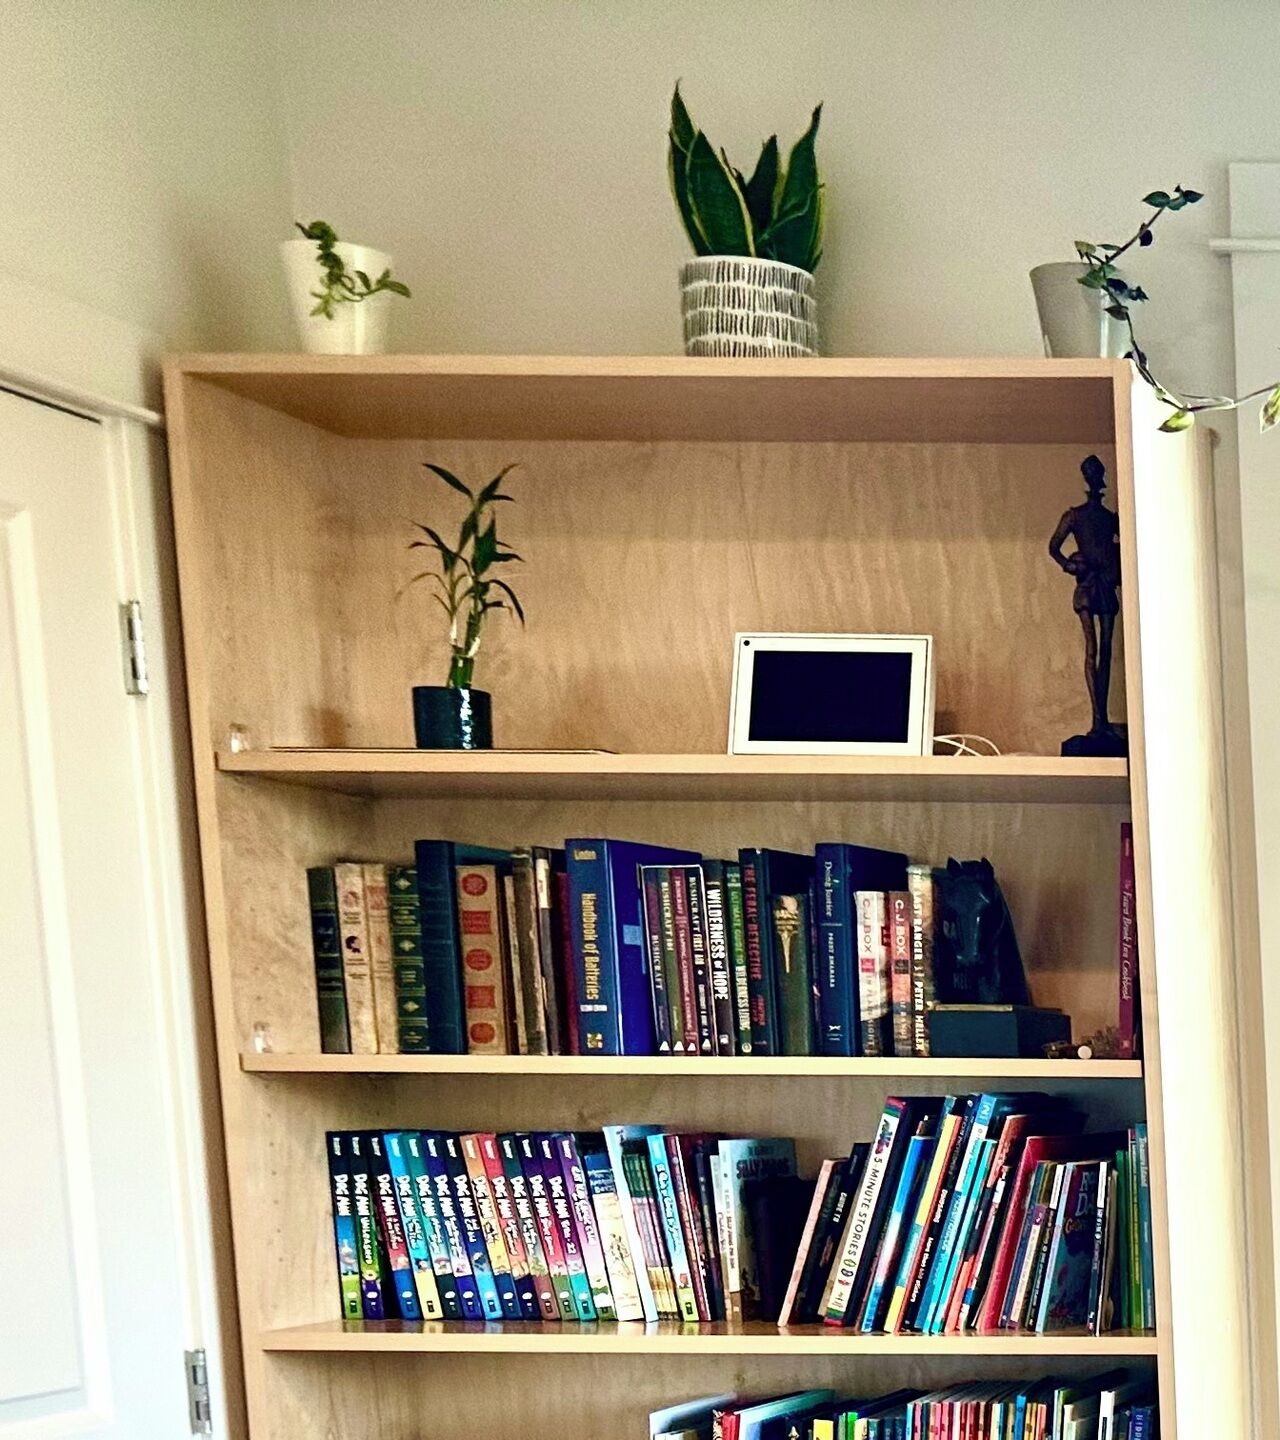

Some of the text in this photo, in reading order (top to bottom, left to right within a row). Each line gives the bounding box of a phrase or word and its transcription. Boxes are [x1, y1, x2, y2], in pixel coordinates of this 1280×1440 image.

[689, 877, 700, 932] BUSHCRAFT
[745, 887, 758, 917] FERAL
[824, 861, 833, 917] Doing Justice
[581, 893, 596, 940] Handbook
[661, 882, 672, 936] BUSHCRAFT
[584, 943, 598, 953] of
[707, 889, 728, 1000] WILDERNESS HOPE
[747, 923, 761, 980] DETECTIVE
[863, 925, 872, 953] BOX
[896, 926, 905, 956] BOX
[913, 918, 923, 960] RANGER
[584, 956, 600, 1000] Batteries
[652, 935, 663, 990] BUSHCRAFT
[735, 965, 748, 1008] WILDERNESS
[416, 1175, 429, 1196] DOG
[455, 1174, 468, 1196] DOG
[472, 1176, 486, 1197] DOG
[492, 1176, 505, 1197] DOG
[510, 1176, 524, 1197] DOG
[571, 1167, 582, 1181] CAT
[575, 1183, 585, 1199] KID
[334, 1174, 351, 1216] DOG MAN
[377, 1174, 396, 1217] DOG MAN
[397, 1175, 415, 1217] DOG MAN
[420, 1197, 436, 1217] MAN
[434, 1174, 455, 1217] DOG MAN
[459, 1197, 474, 1217] MAN
[478, 1199, 493, 1219] MAN
[497, 1199, 512, 1219] MAN
[515, 1199, 531, 1219] MAN
[530, 1175, 550, 1217] DOG MAN
[549, 1176, 569, 1218] DOG MAN
[579, 1201, 591, 1225] COMIC
[353, 1174, 373, 1264] DOG MAN UNLEASHED
[585, 1226, 596, 1245] CLUB
[847, 1211, 868, 1257] STORIES
